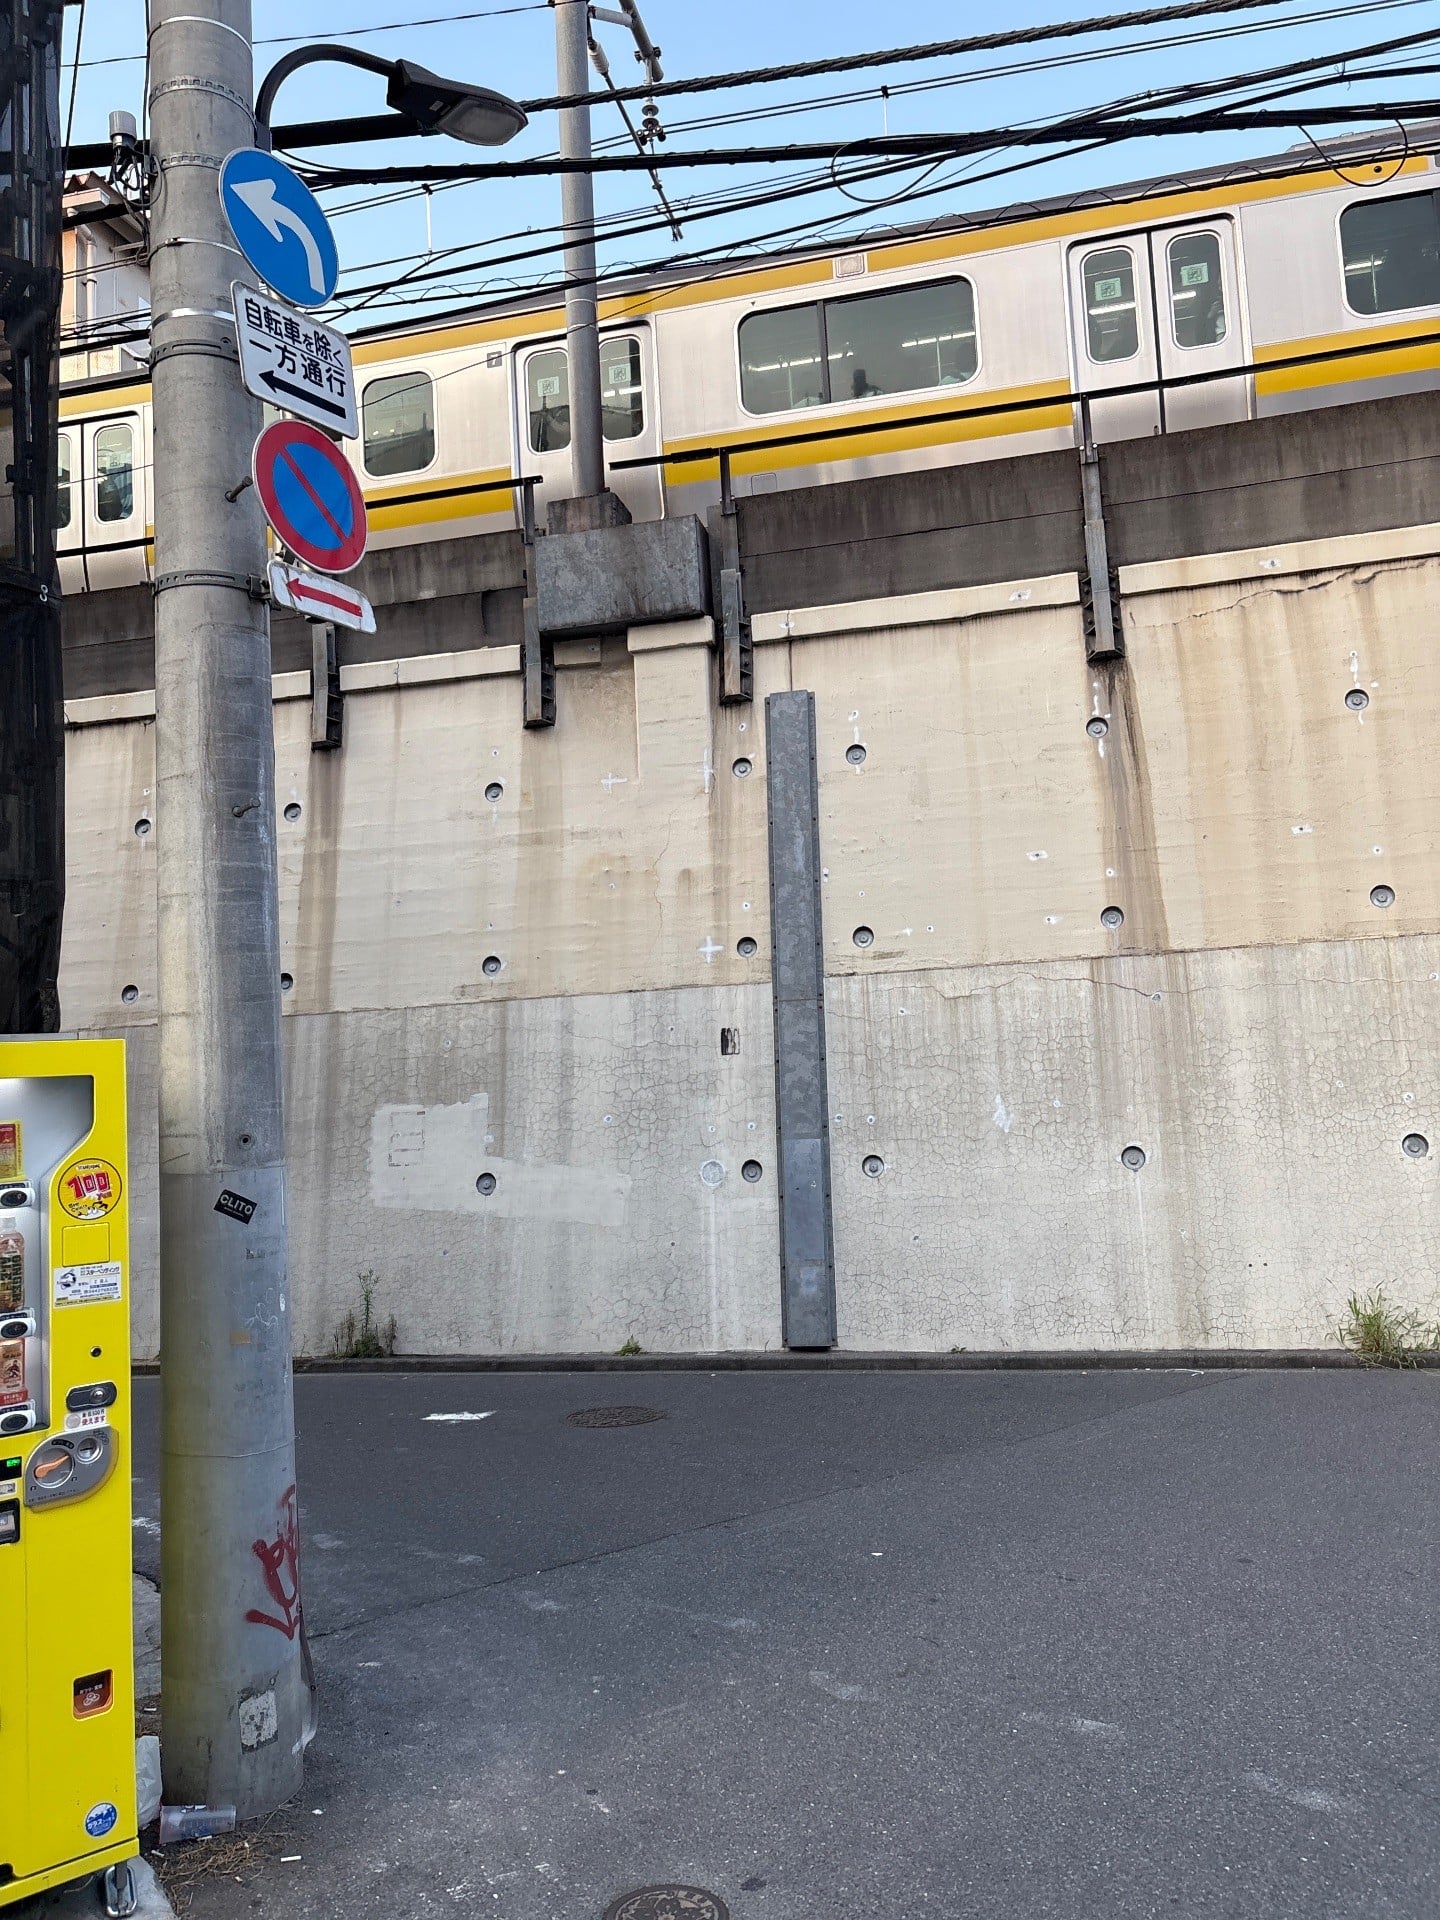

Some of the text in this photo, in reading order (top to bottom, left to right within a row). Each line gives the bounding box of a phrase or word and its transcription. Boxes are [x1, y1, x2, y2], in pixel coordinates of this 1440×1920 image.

[245, 298, 343, 367] 自転車を除く
[249, 339, 346, 397] 一方通行
[66, 1171, 111, 1199] 100
[220, 1194, 253, 1215] CLITO
[12, 1254, 22, 1302] GINGER
[81, 1415, 106, 1426] 使えます
